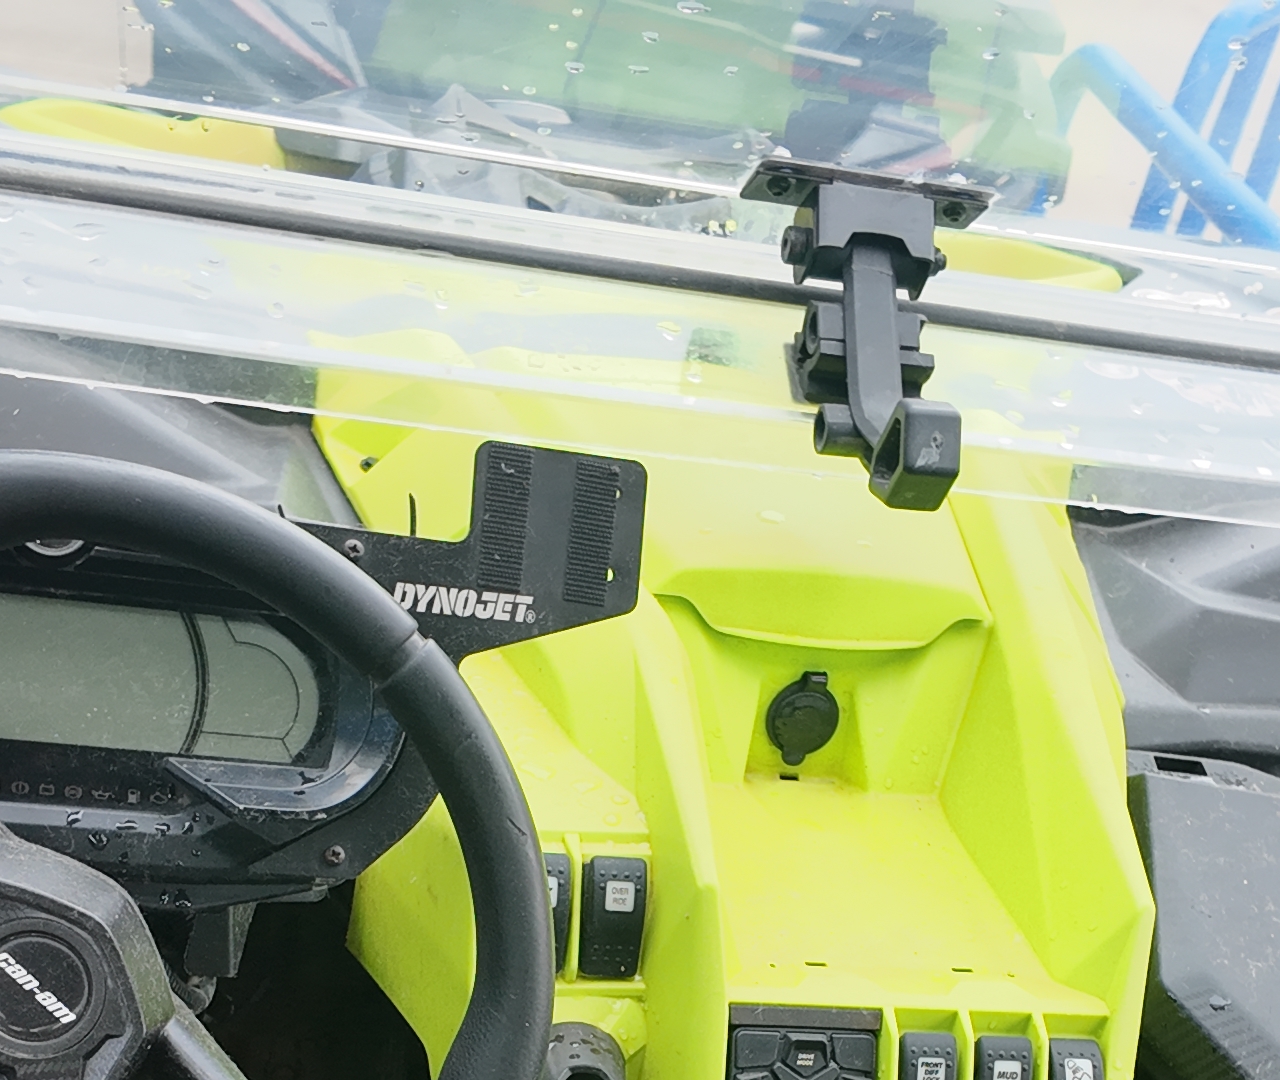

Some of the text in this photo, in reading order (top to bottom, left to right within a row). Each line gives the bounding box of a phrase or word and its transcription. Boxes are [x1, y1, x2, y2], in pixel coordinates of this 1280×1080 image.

[612, 887, 629, 895] OVER
[613, 897, 628, 906] RIDE
[997, 1071, 1018, 1080] MUD
